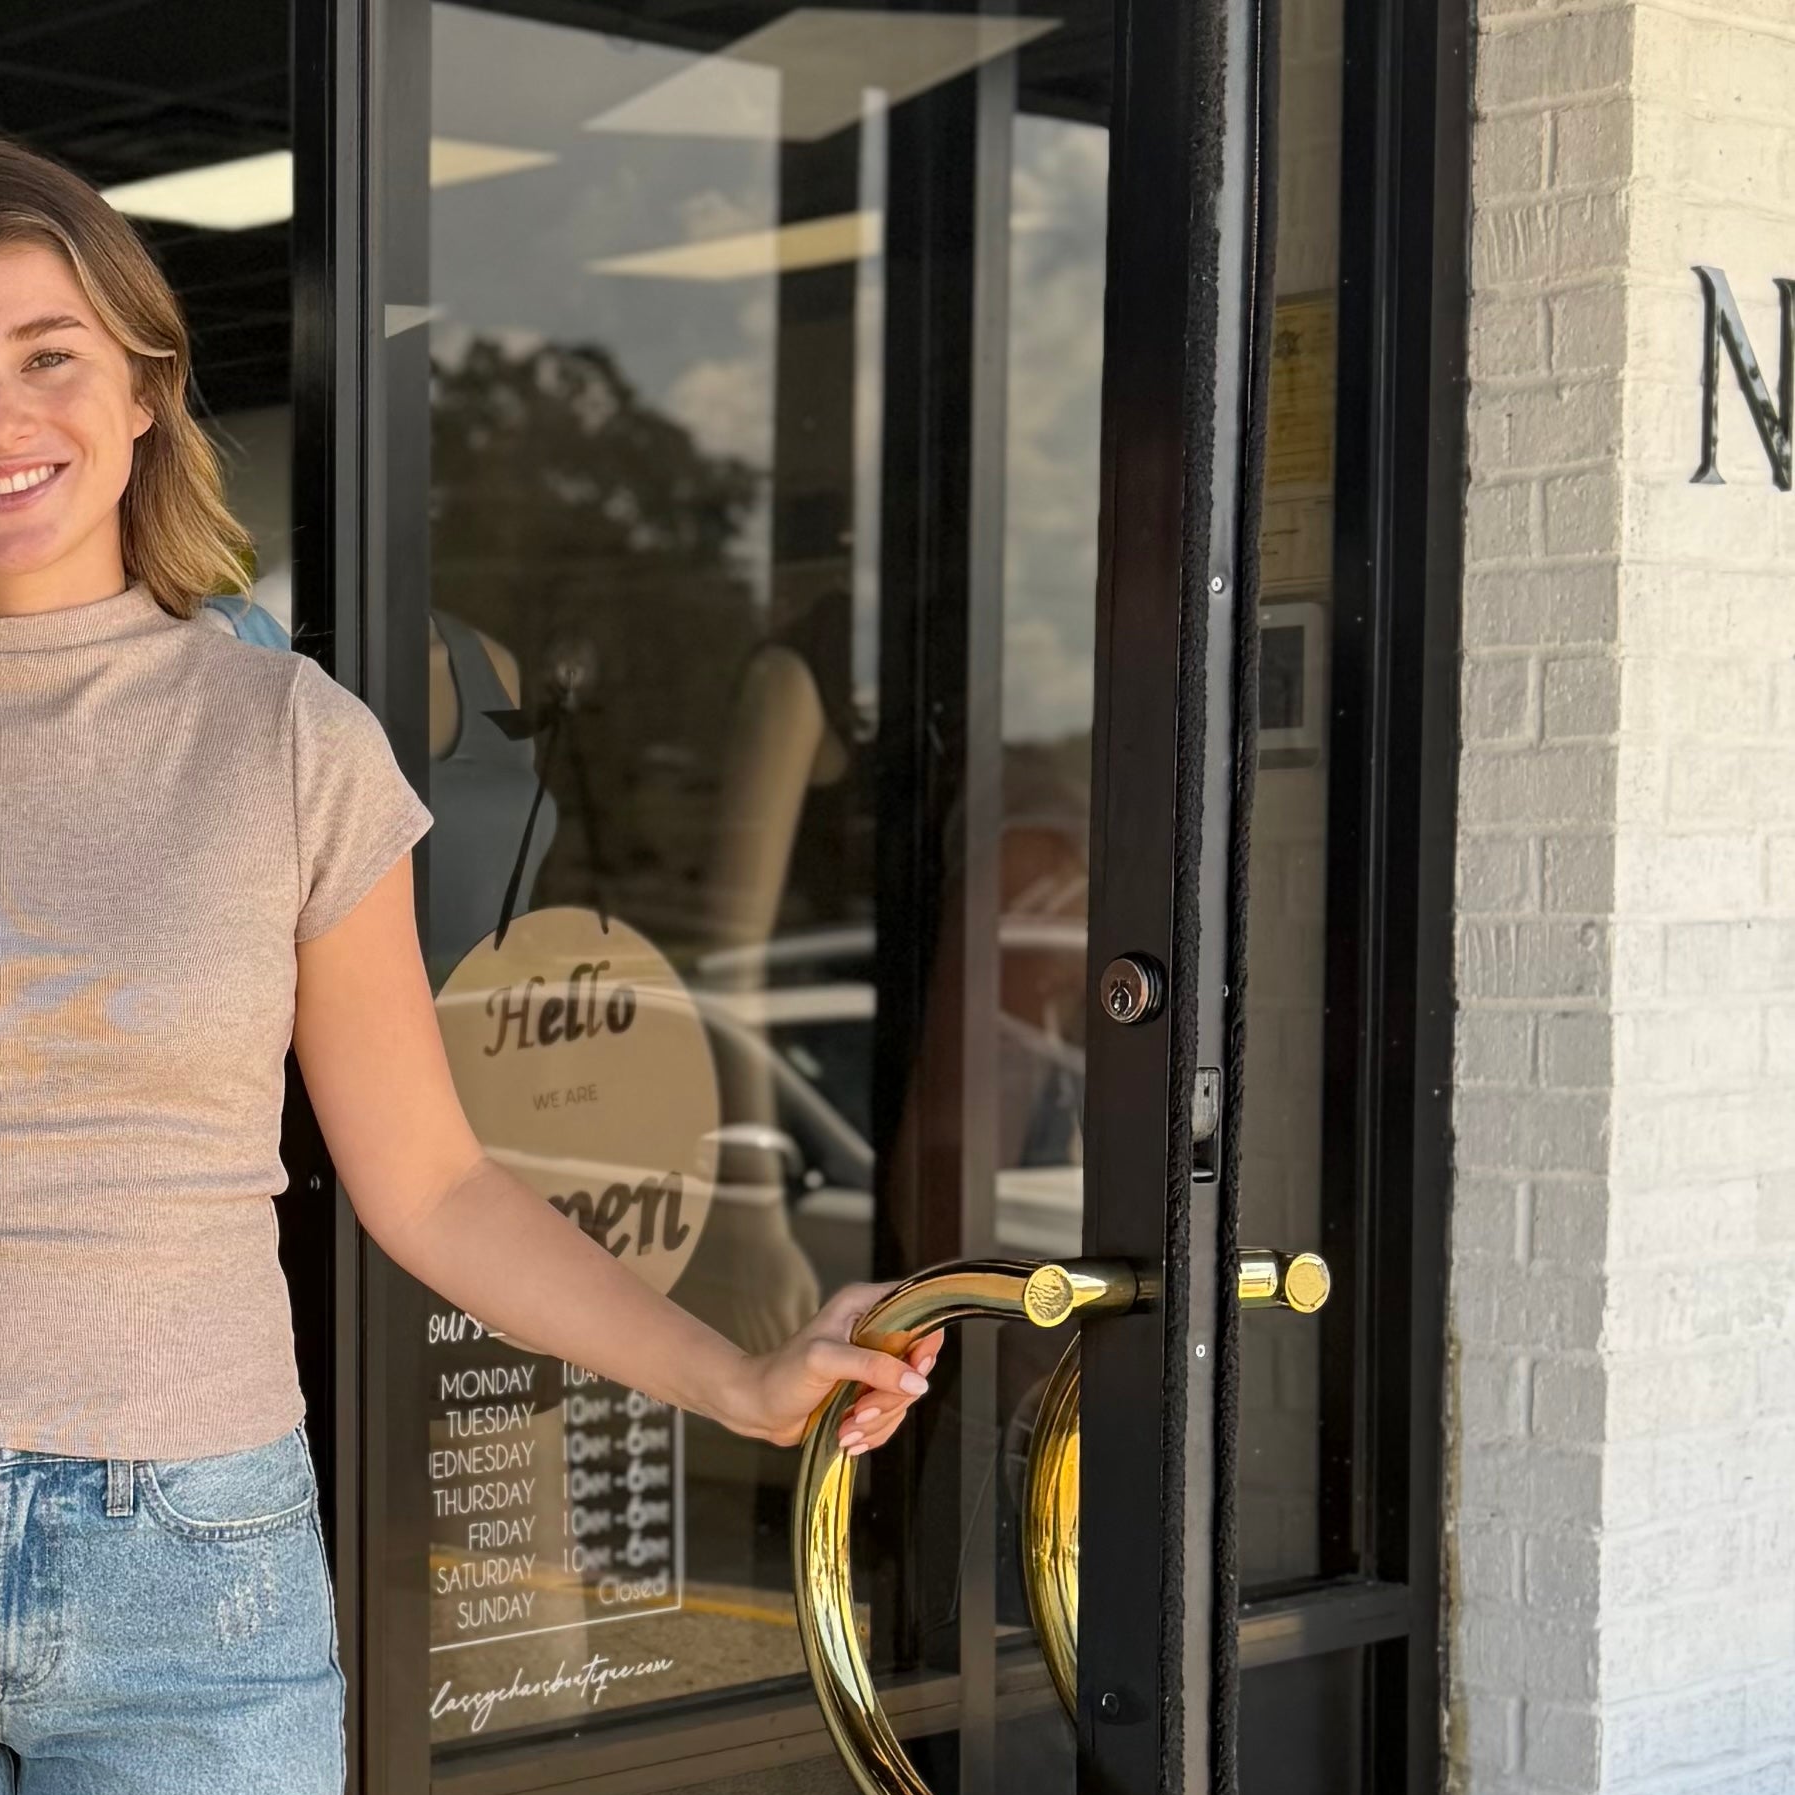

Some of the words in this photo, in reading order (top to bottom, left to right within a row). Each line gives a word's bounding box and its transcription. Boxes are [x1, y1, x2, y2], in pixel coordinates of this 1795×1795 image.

[483, 960, 637, 1058] Hello
[533, 1092, 560, 1112] WE
[565, 1083, 599, 1106] ARE
[547, 1171, 691, 1258] pen
[441, 1364, 536, 1400] MONDAY
[446, 1402, 536, 1439] TUESDAY
[428, 1440, 536, 1480] EDNESDAY
[433, 1478, 536, 1517] THURSDAY
[469, 1515, 537, 1550] FRIDAY
[436, 1553, 537, 1594] SATURDAY
[457, 1591, 536, 1629] SUNDAY
[597, 1568, 669, 1604] Closed
